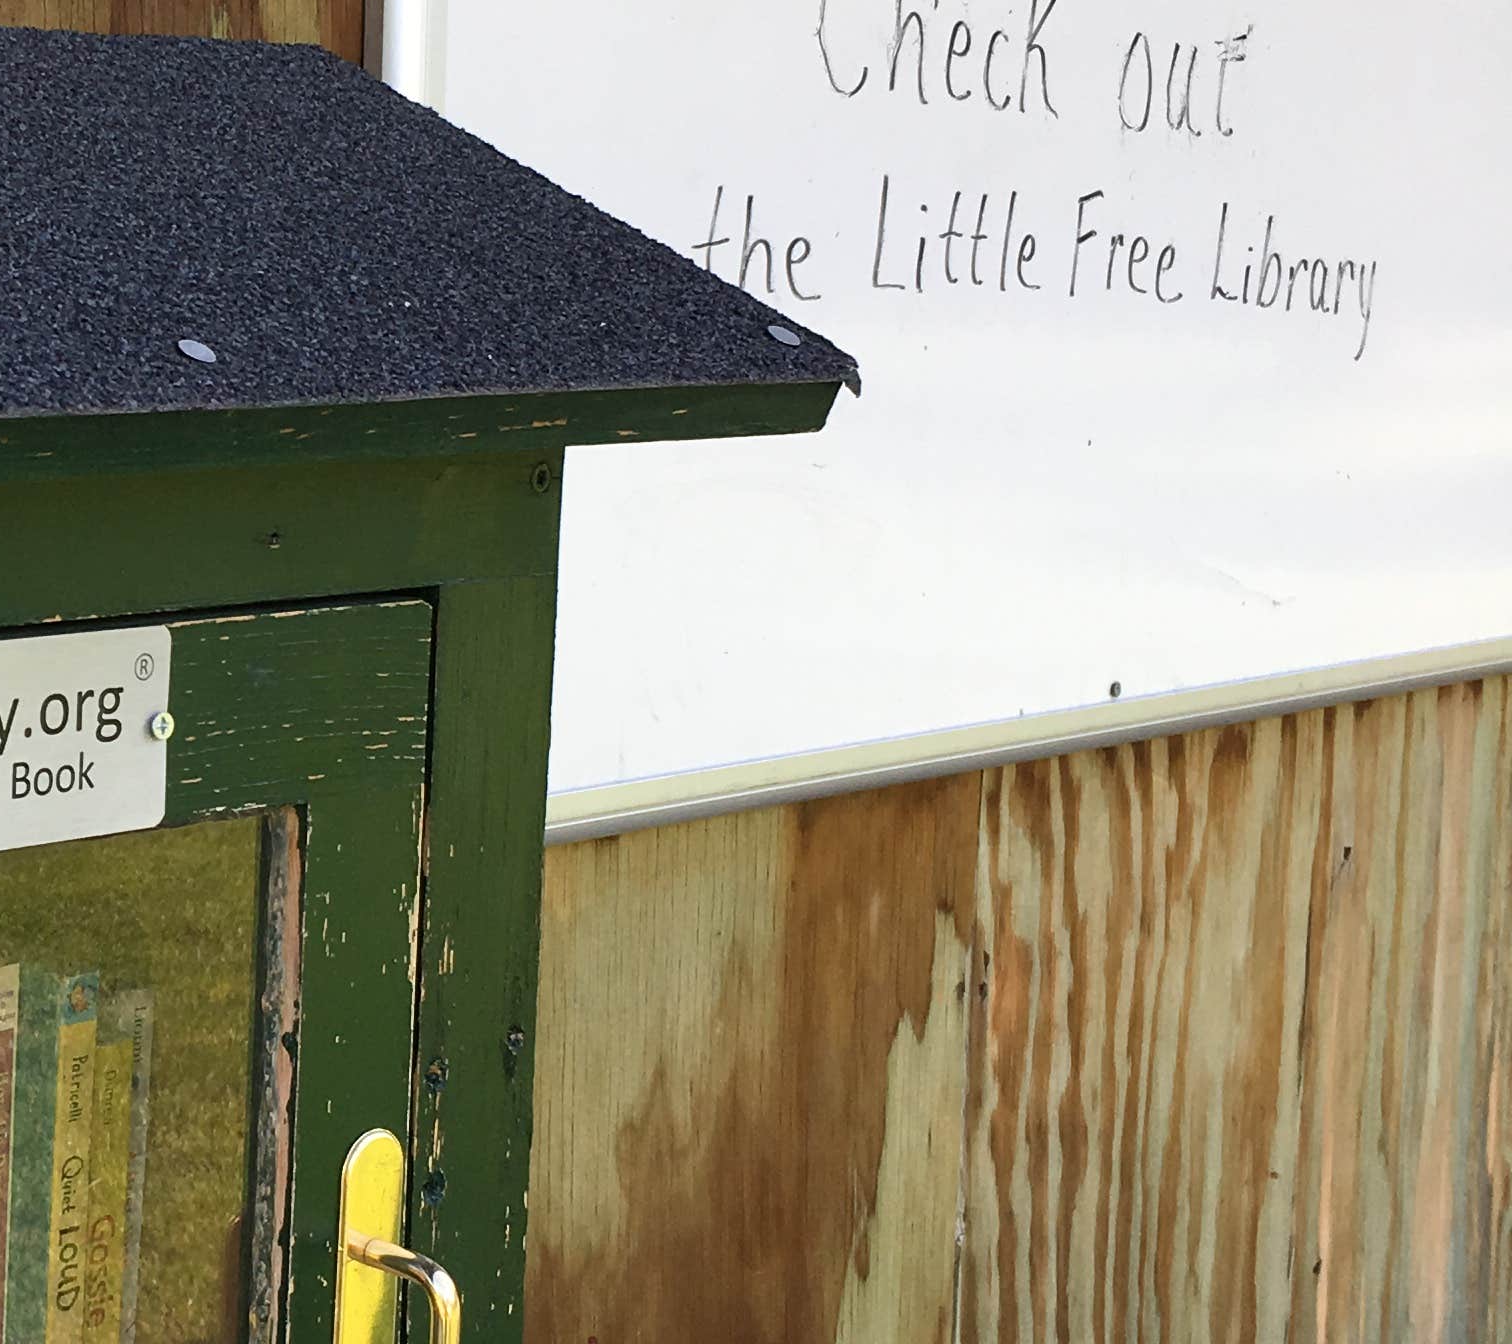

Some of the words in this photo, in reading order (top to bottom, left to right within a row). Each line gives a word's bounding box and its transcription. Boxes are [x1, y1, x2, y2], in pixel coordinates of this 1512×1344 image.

[1119, 27, 1252, 137] out
[692, 186, 821, 301] the
[873, 175, 1041, 293] Little
[1068, 191, 1183, 303] Free
[1210, 202, 1379, 361] Library
[10, 752, 95, 794] Book
[61, 1155, 84, 1216] Quiet
[56, 1225, 81, 1312] LOUD
